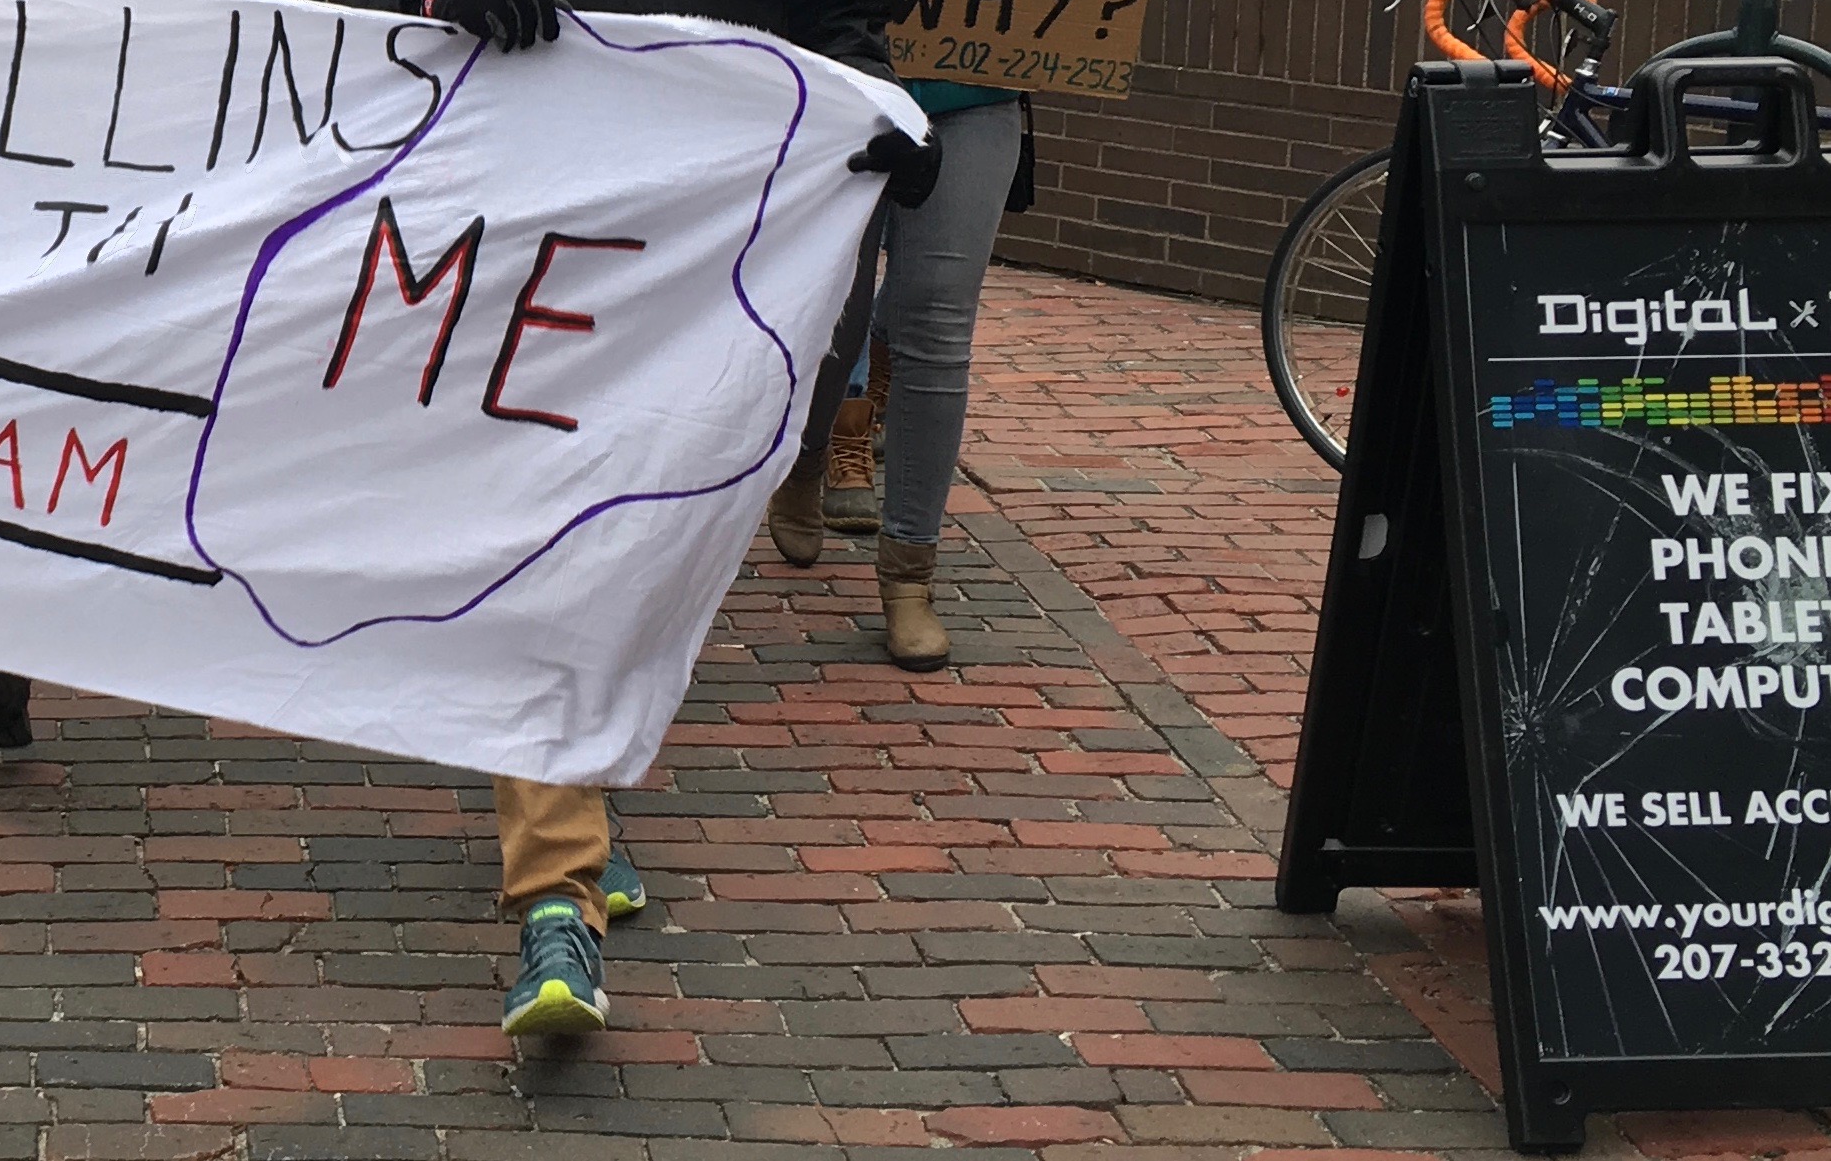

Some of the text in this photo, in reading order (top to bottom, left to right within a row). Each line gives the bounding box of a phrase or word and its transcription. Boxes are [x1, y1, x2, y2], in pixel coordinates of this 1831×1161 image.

[934, 37, 1133, 93] 202-224-2523
[323, 196, 647, 434] ME
[1661, 473, 1752, 516] WE
[1556, 789, 1831, 828] WE SELL ACC
